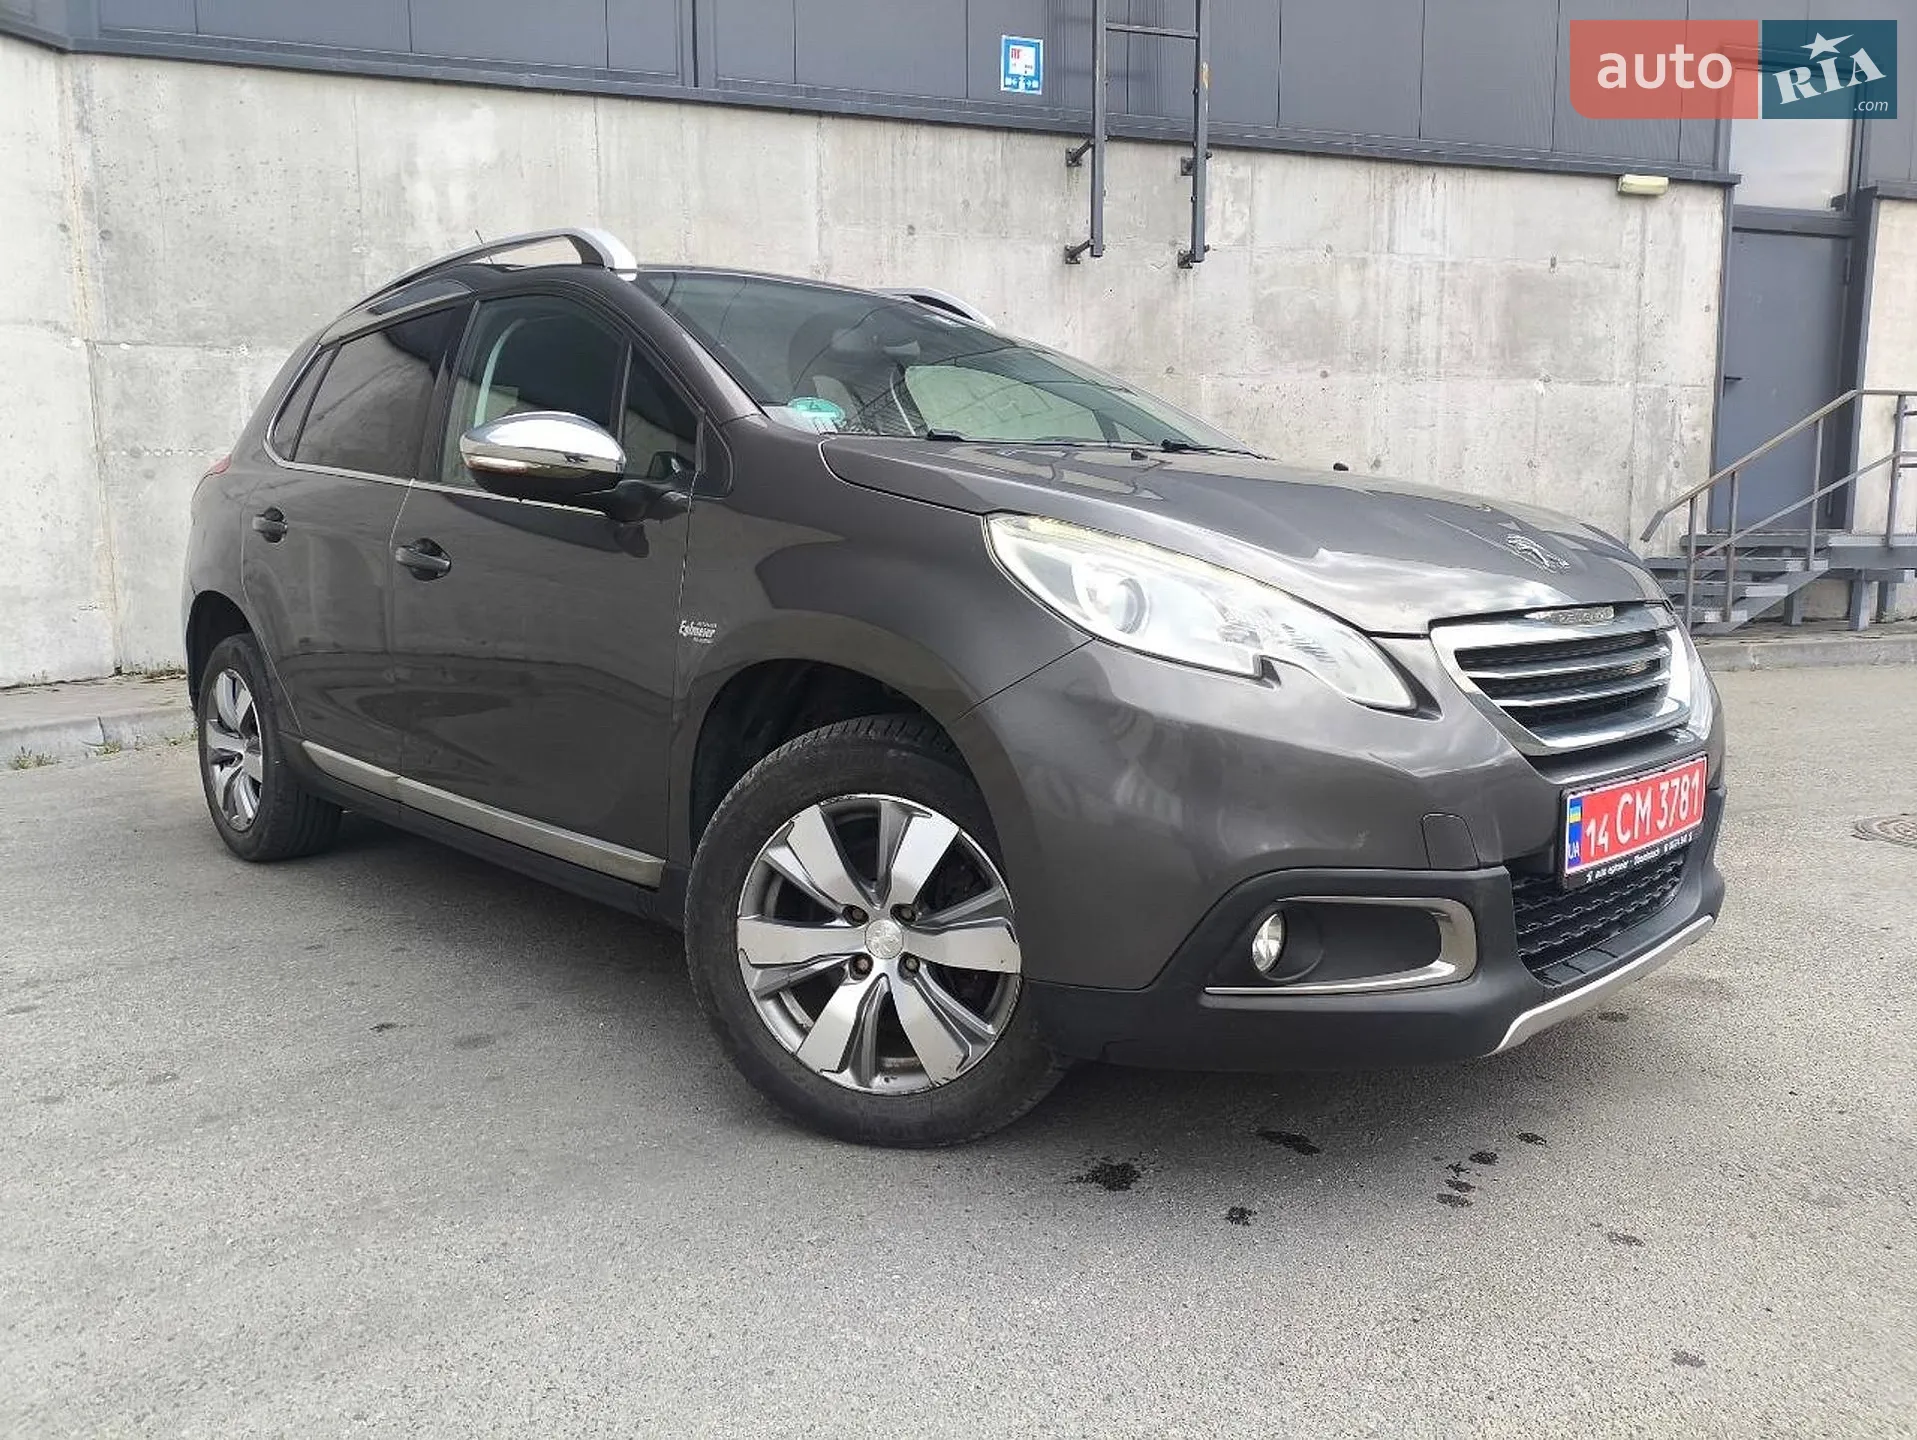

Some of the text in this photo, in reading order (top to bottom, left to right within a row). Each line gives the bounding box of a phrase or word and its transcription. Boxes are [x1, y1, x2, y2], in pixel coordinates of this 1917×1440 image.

[1585, 768, 1701, 858] 14 CM 3781
[1567, 840, 1580, 860] UA
